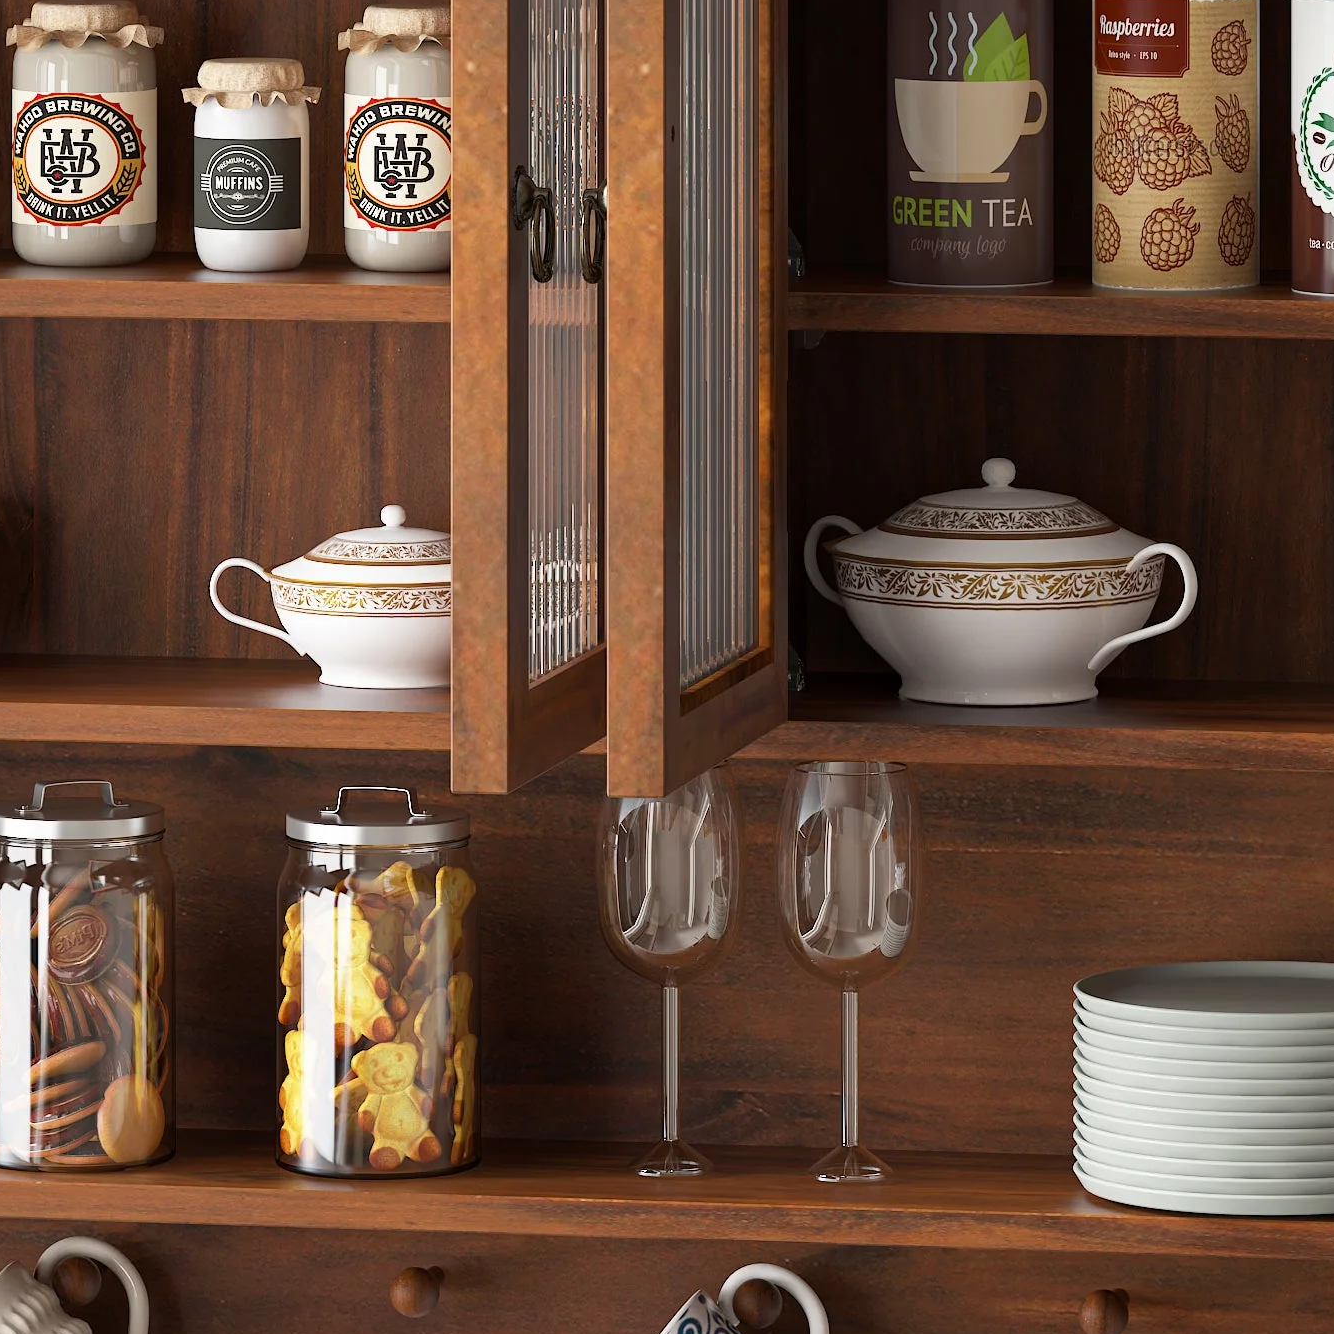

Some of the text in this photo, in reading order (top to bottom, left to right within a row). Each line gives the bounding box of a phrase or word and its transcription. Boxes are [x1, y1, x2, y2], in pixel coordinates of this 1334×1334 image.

[1099, 14, 1175, 41] Raspberries
[1139, 51, 1149, 60] EPS
[15, 99, 137, 158] WAHOO BREWING CO.
[347, 104, 451, 159] WAHOO BREWIN
[216, 157, 262, 173] PREMIUM CAFE
[215, 175, 263, 190] MUFFINS
[25, 192, 55, 217] DRINK
[56, 206, 72, 219] IT.
[72, 201, 104, 219] YELL
[359, 197, 388, 221] DRINK
[390, 211, 406, 224] IT.
[406, 206, 439, 223] YELL
[892, 195, 1033, 228] GREEN TEA
[910, 234, 1007, 260] company logo
